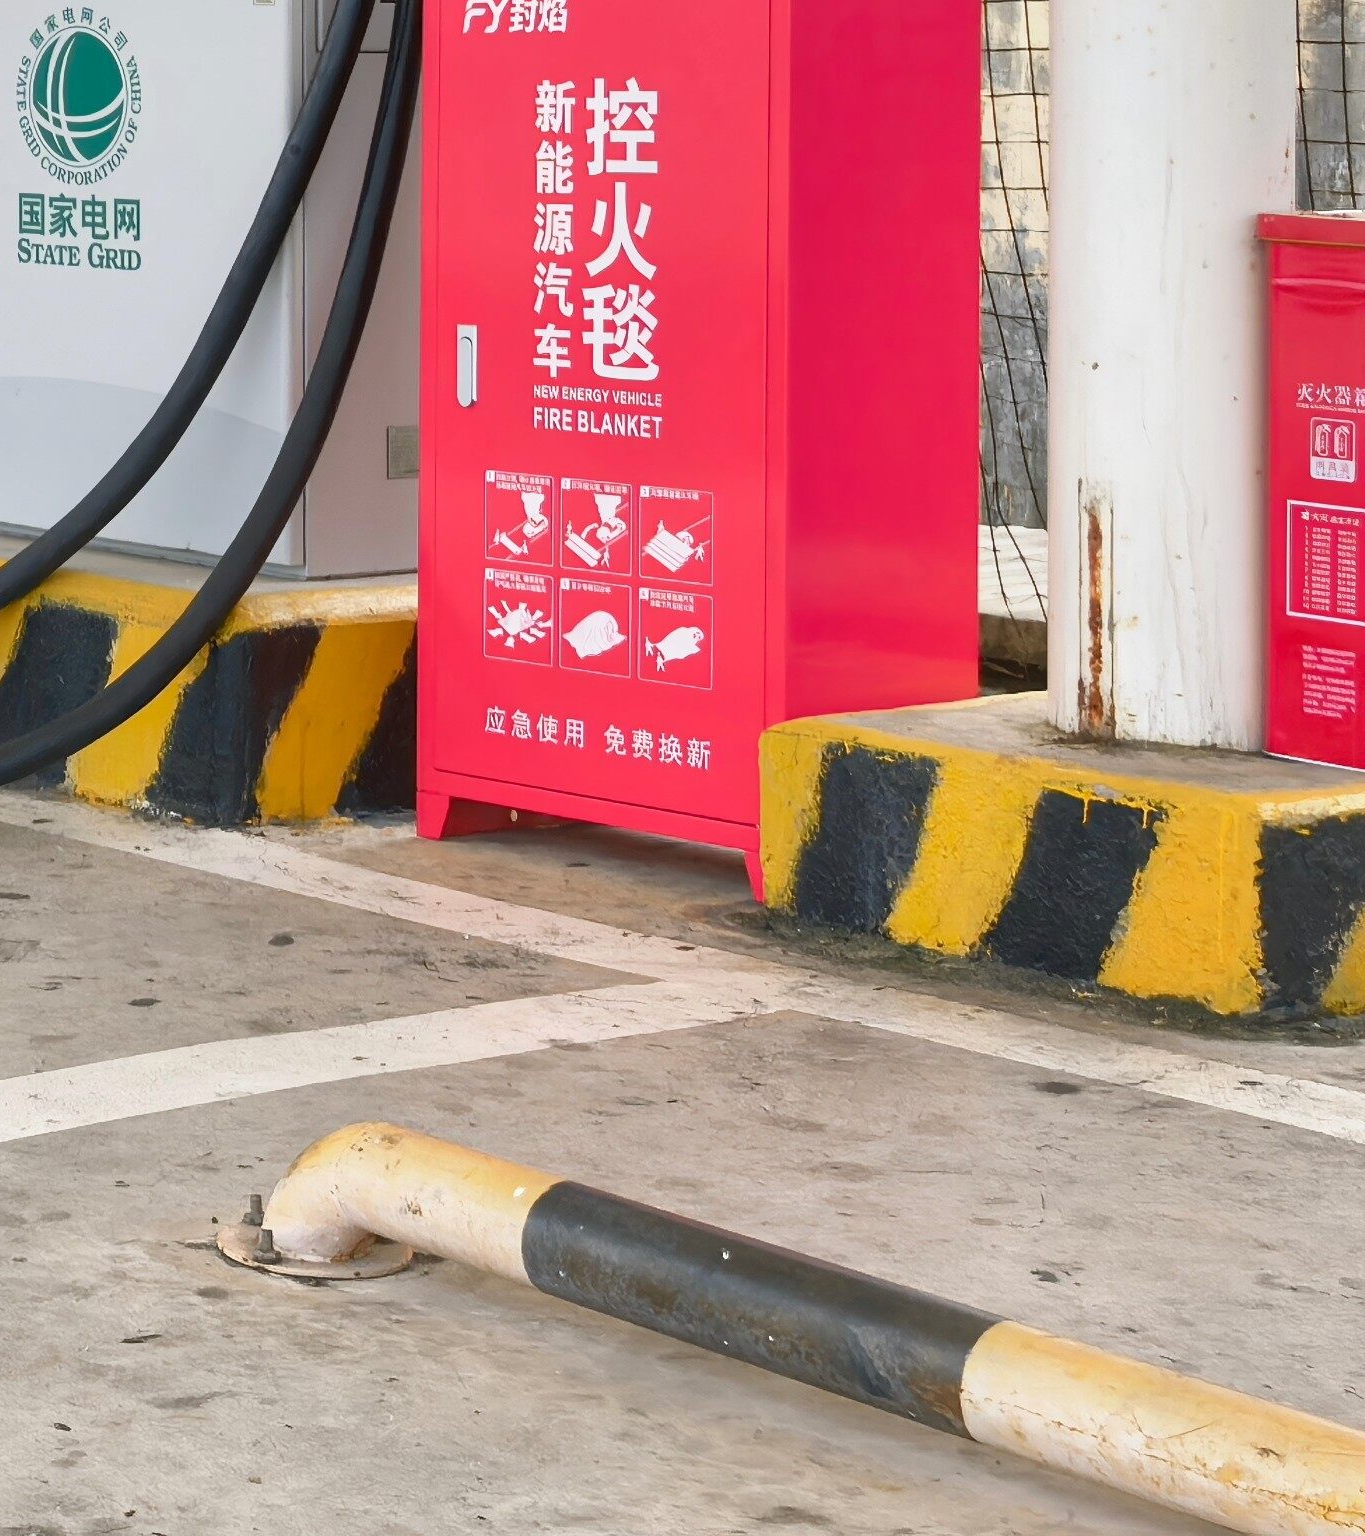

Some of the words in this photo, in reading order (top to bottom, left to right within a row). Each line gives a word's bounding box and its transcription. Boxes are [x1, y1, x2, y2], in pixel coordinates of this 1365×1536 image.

[18, 116, 42, 158] GRID
[40, 146, 129, 186] CORPORATION
[126, 55, 142, 114] CHINA
[19, 192, 141, 242] 国家电网
[532, 79, 577, 378] 新能源汽车
[582, 77, 660, 382] 控火毯
[17, 238, 81, 267] STATE
[87, 242, 142, 272] GRID
[532, 385, 560, 401] NEW
[562, 385, 610, 404] ENERGY
[611, 390, 663, 409] VEHICLE
[532, 406, 573, 432] FIRE
[576, 410, 663, 440] BLANKET
[485, 705, 585, 749] 应急使用
[603, 724, 711, 771] 免费换新
